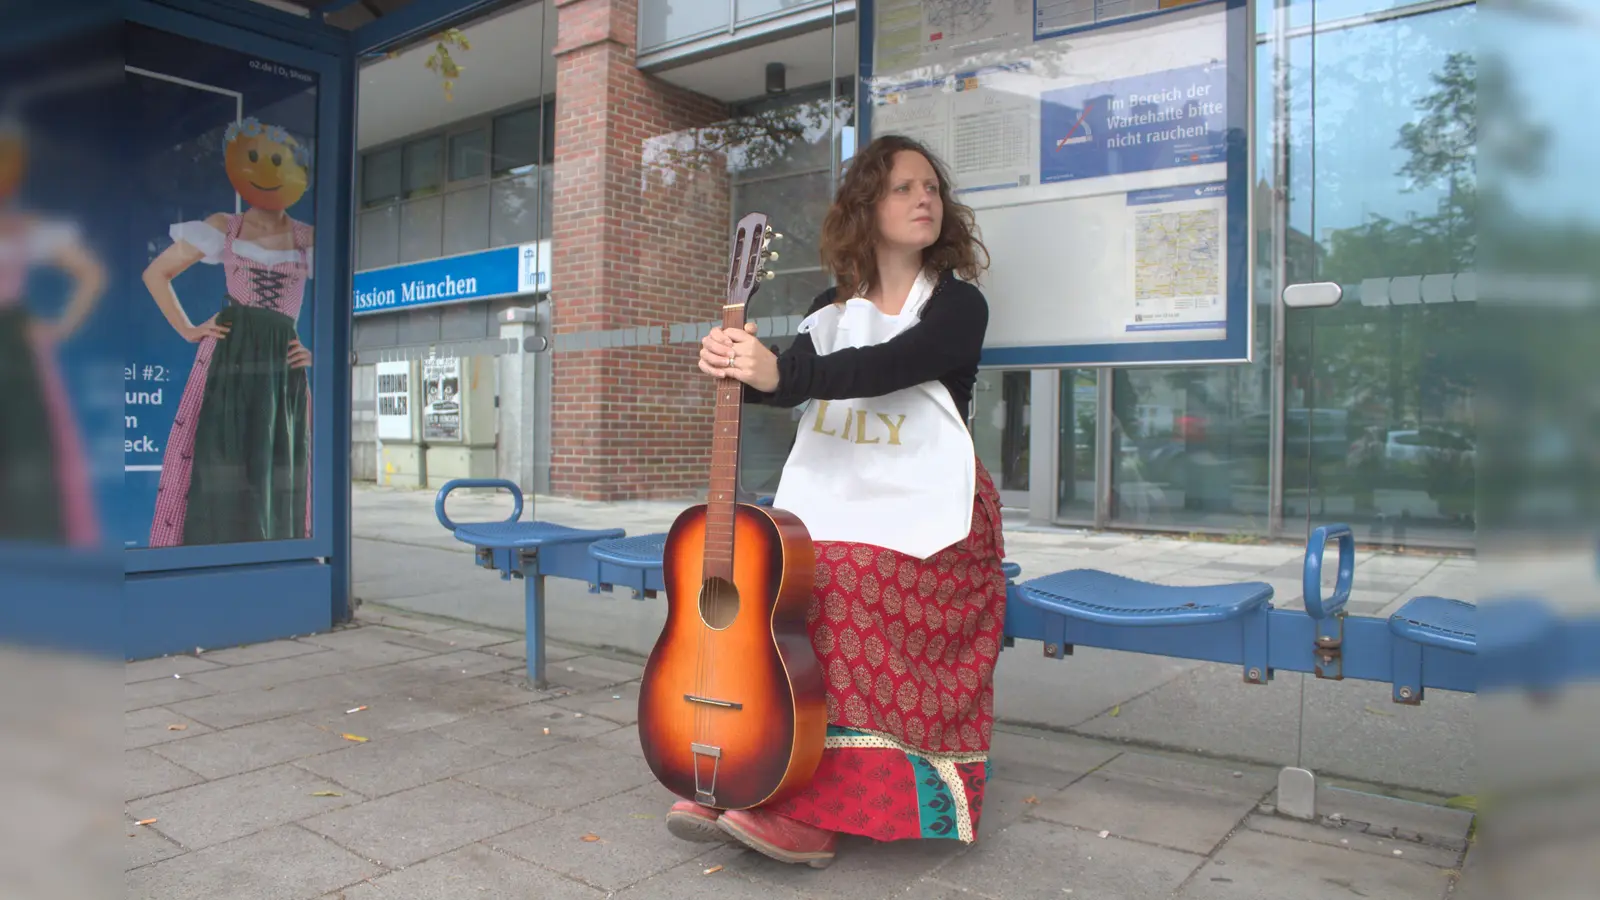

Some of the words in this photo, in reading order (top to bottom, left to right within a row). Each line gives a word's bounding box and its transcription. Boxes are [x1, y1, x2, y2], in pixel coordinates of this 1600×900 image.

[1107, 98, 1124, 111] Im
[1129, 86, 1182, 107] Bereich
[1187, 82, 1212, 98] der
[1106, 107, 1183, 130] Wartehalle
[1188, 102, 1223, 118] bitte
[1106, 131, 1142, 149] nicht
[1146, 122, 1209, 143] rauchen!
[401, 274, 477, 302] München
[142, 365, 171, 382] #2:
[125, 388, 163, 405] und
[812, 400, 906, 445] LILY
